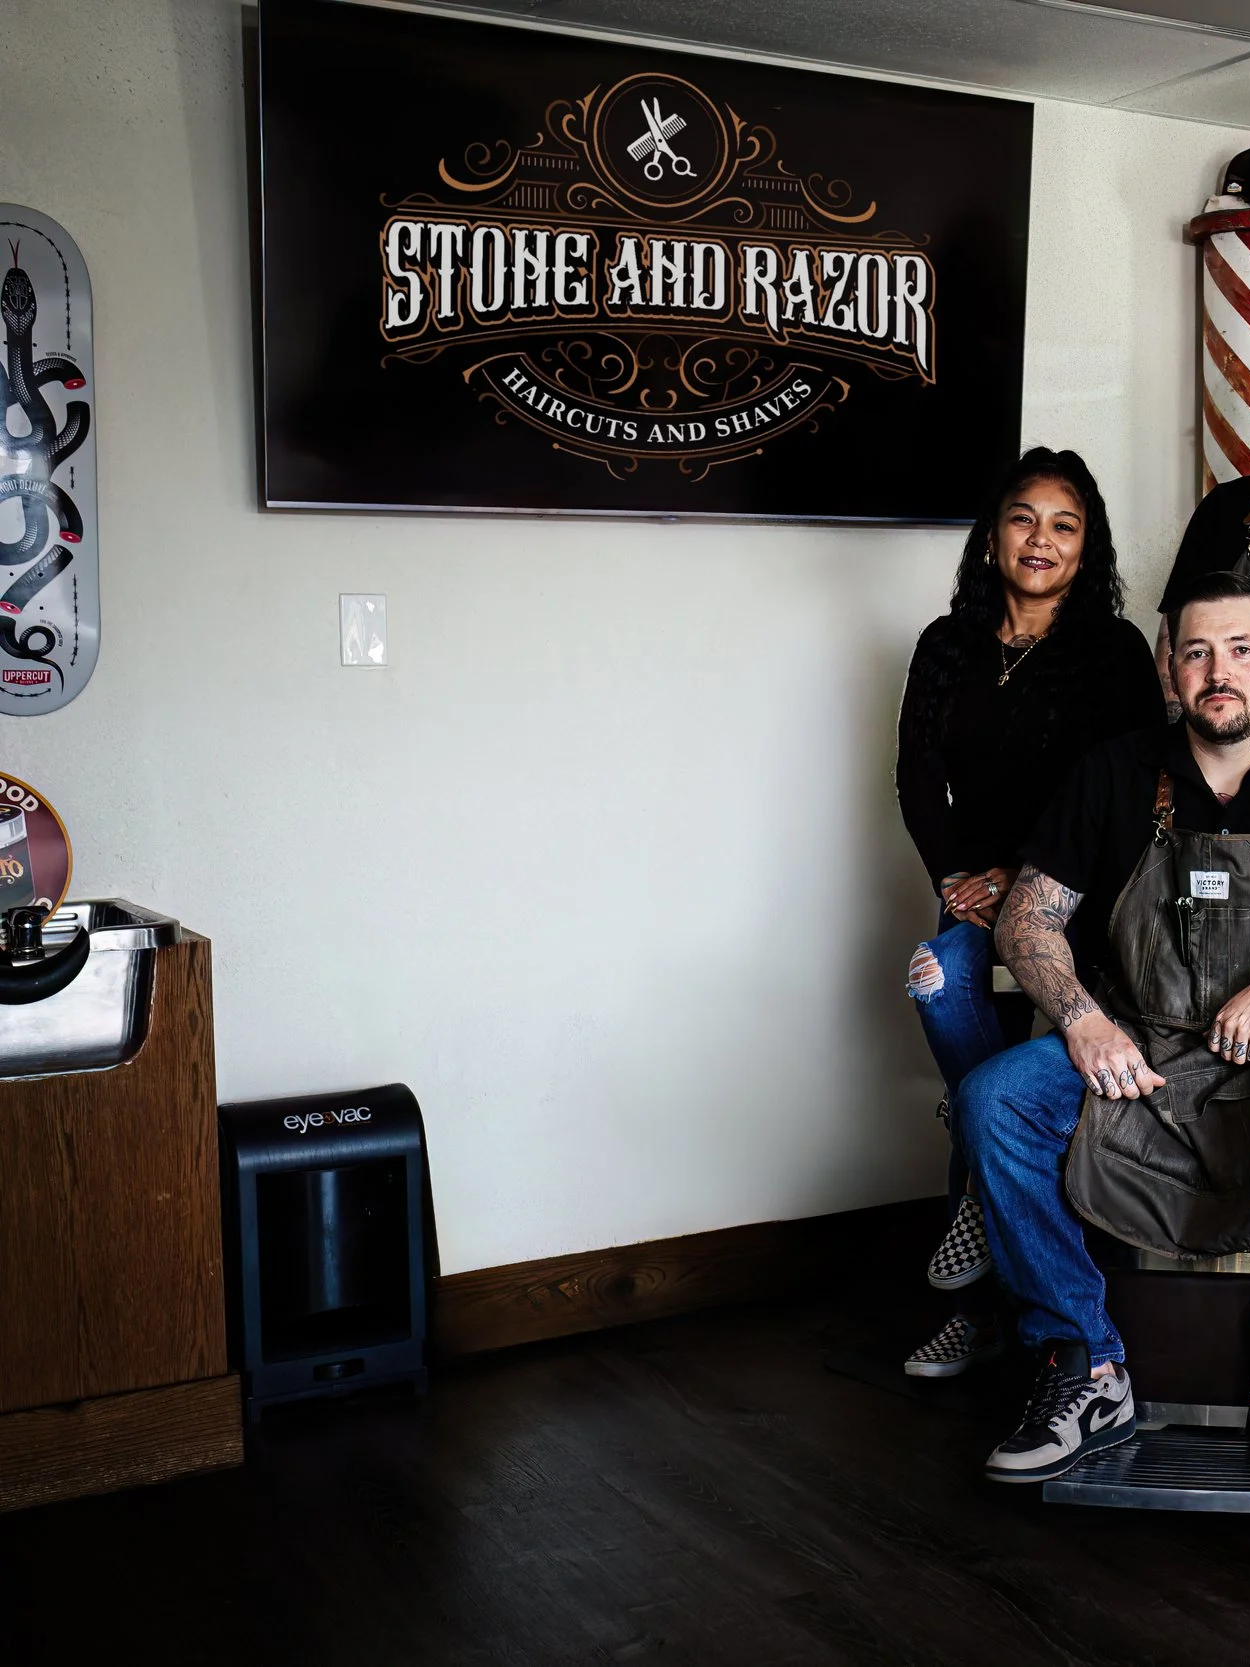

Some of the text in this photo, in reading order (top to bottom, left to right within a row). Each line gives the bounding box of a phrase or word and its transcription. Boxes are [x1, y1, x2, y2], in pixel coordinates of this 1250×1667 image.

[384, 221, 929, 372] STONE AND RAZOR
[502, 367, 813, 444] HAIRCUTS AND SHAVES
[4, 670, 50, 683] UPPERCUT
